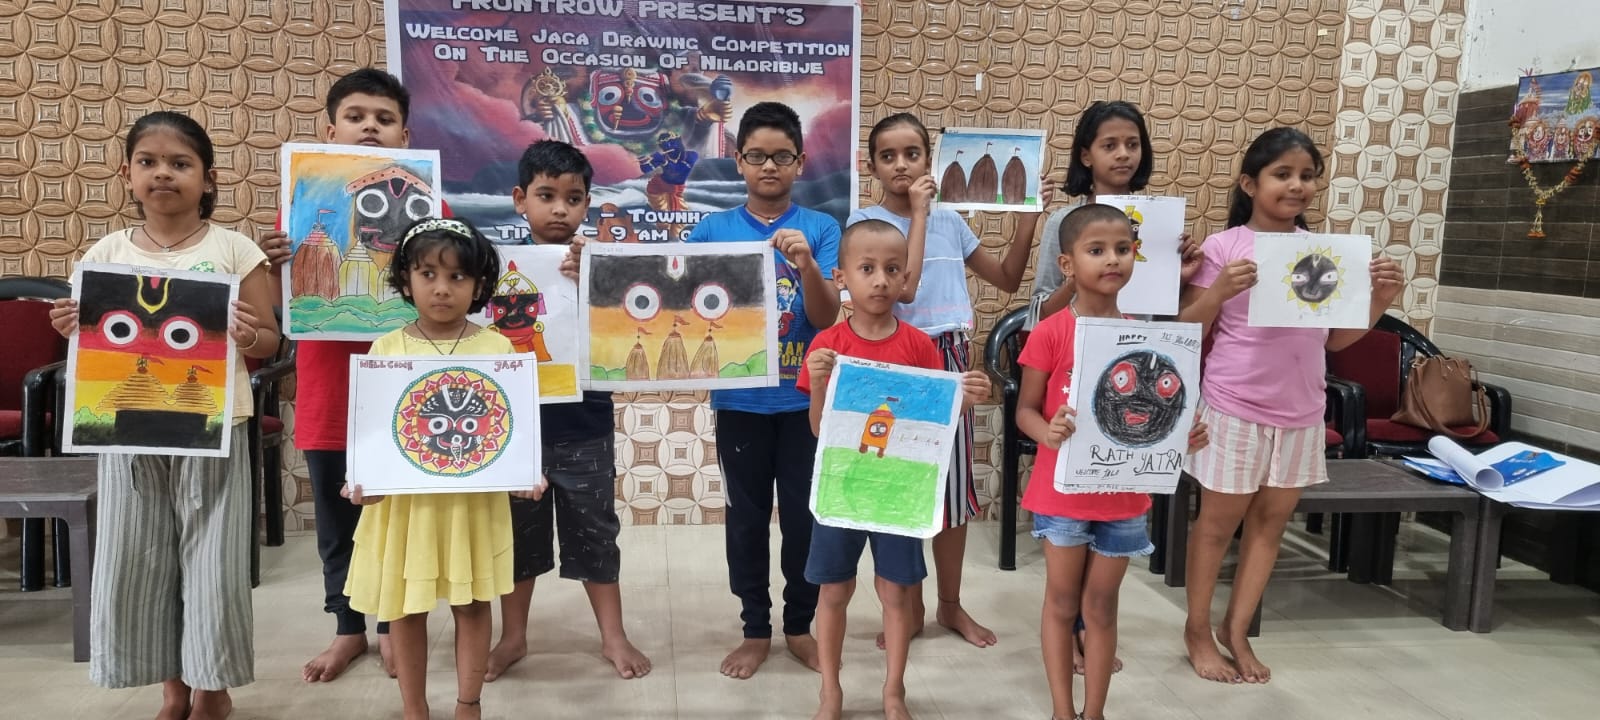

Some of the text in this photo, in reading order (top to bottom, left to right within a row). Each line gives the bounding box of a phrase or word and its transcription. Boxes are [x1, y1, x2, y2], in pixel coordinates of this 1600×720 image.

[638, 2, 806, 26] PRESENT'S
[405, 23, 850, 57] WELCOME JAGA DRAWING COMPETITION
[434, 44, 824, 75] ON THE OCCASION OF NILADRIBIJE
[626, 208, 711, 224] TOWNH
[610, 226, 627, 240] 9
[1090, 444, 1134, 462] RATH
